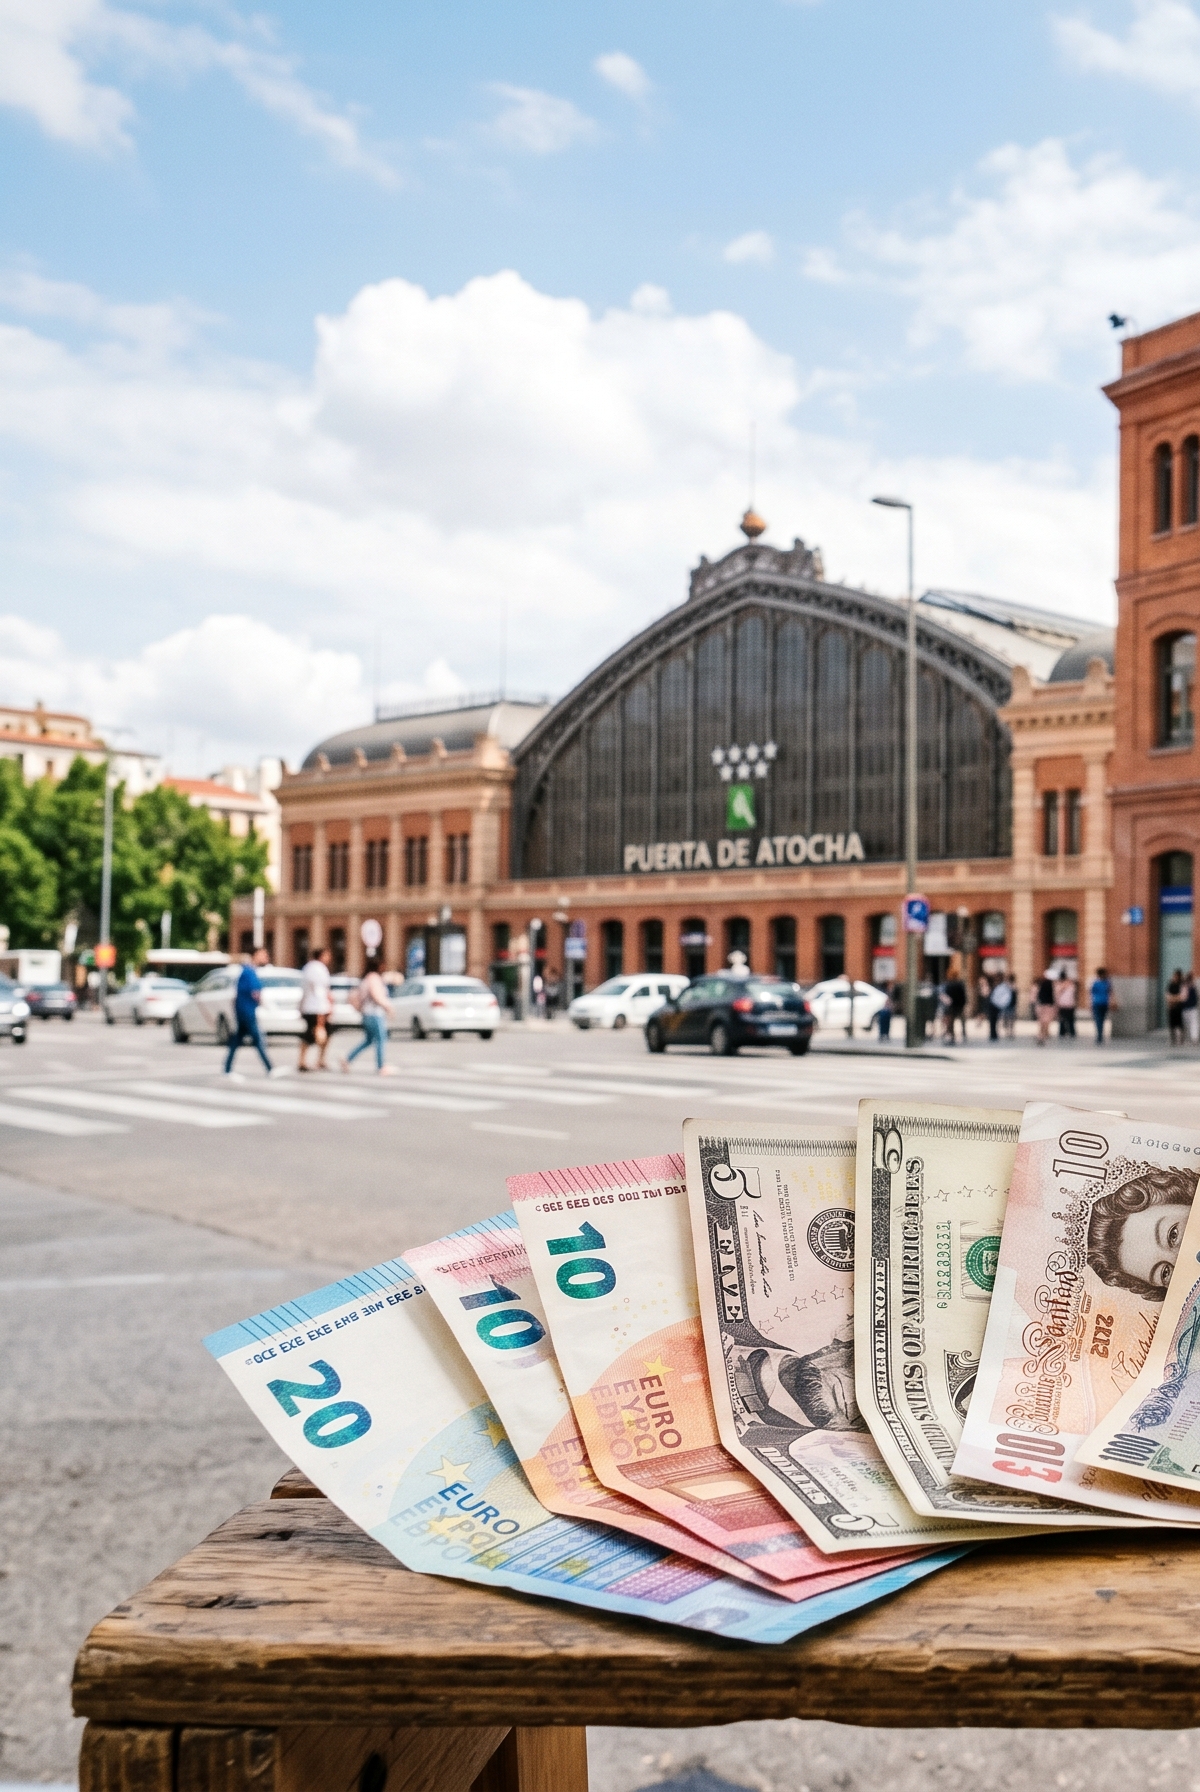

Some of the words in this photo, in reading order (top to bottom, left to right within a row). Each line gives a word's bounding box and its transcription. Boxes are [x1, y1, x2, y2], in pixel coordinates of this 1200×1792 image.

[624, 842, 713, 872] PUERTA
[716, 838, 751, 868] DE
[754, 832, 866, 866] ATOCHA
[707, 1162, 762, 1201] 5
[1052, 1129, 1109, 1184] 10
[545, 1221, 616, 1300] 10
[459, 1274, 546, 1351] 10
[266, 1359, 372, 1449] 20
[639, 1374, 682, 1450] EURO
[992, 1432, 1066, 1484] £10
[1098, 1432, 1162, 1467] 1000
[438, 1482, 521, 1536] EURO
